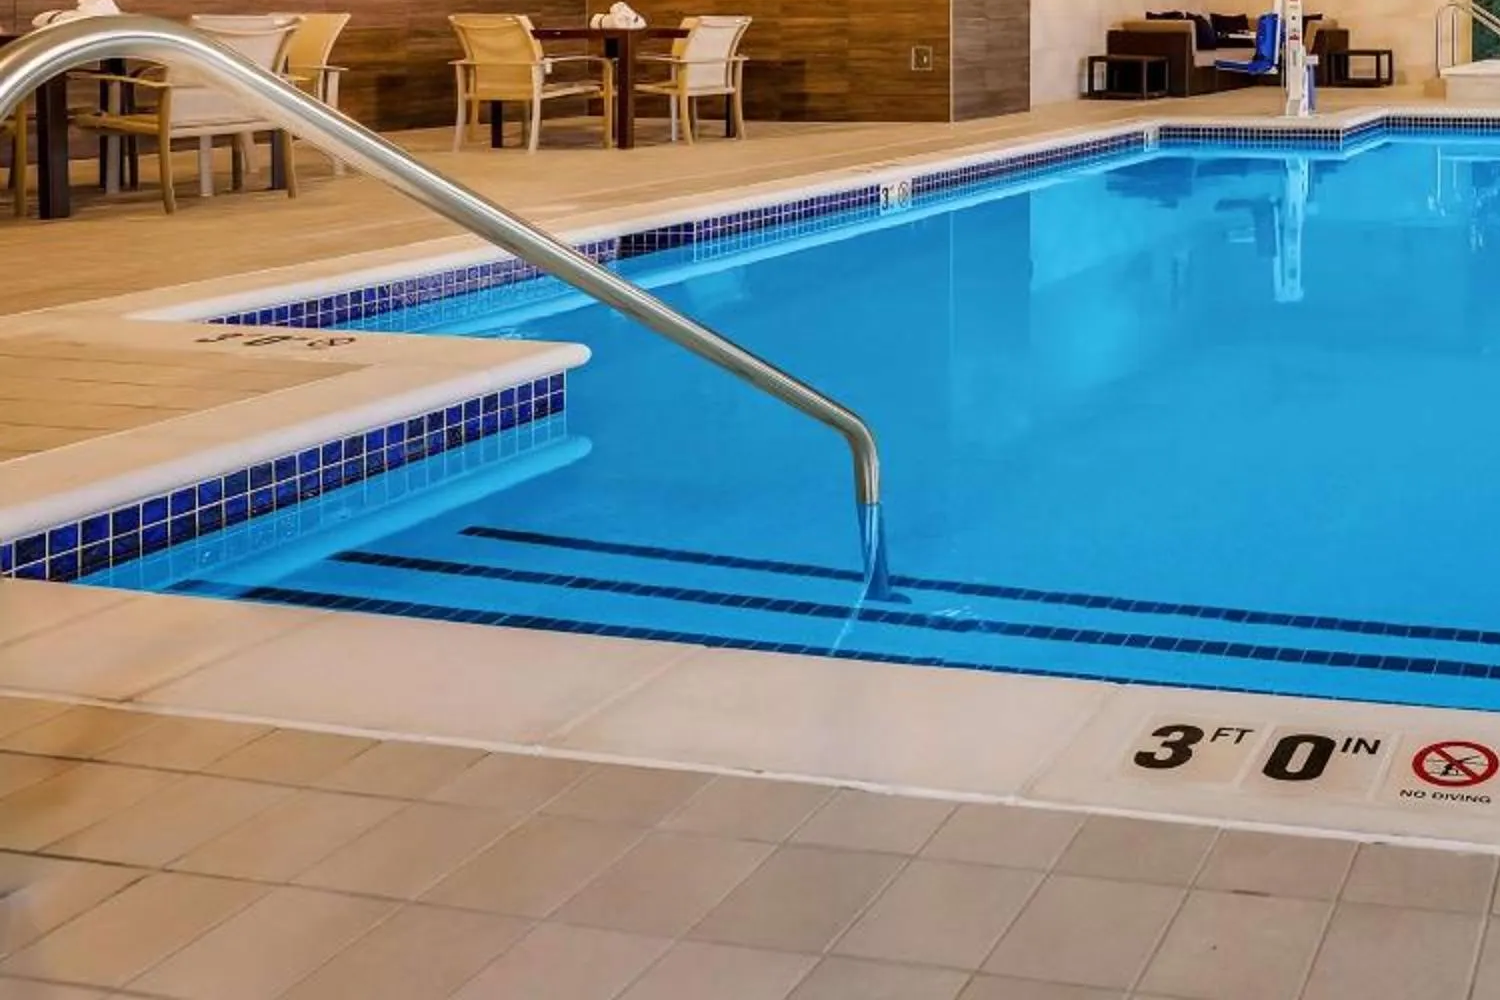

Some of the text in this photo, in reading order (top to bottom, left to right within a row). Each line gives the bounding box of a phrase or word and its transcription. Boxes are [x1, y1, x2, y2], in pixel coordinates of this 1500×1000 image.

[1133, 724, 1381, 781] 3 FT 0 IN
[1399, 788, 1492, 804] NO DIVING
